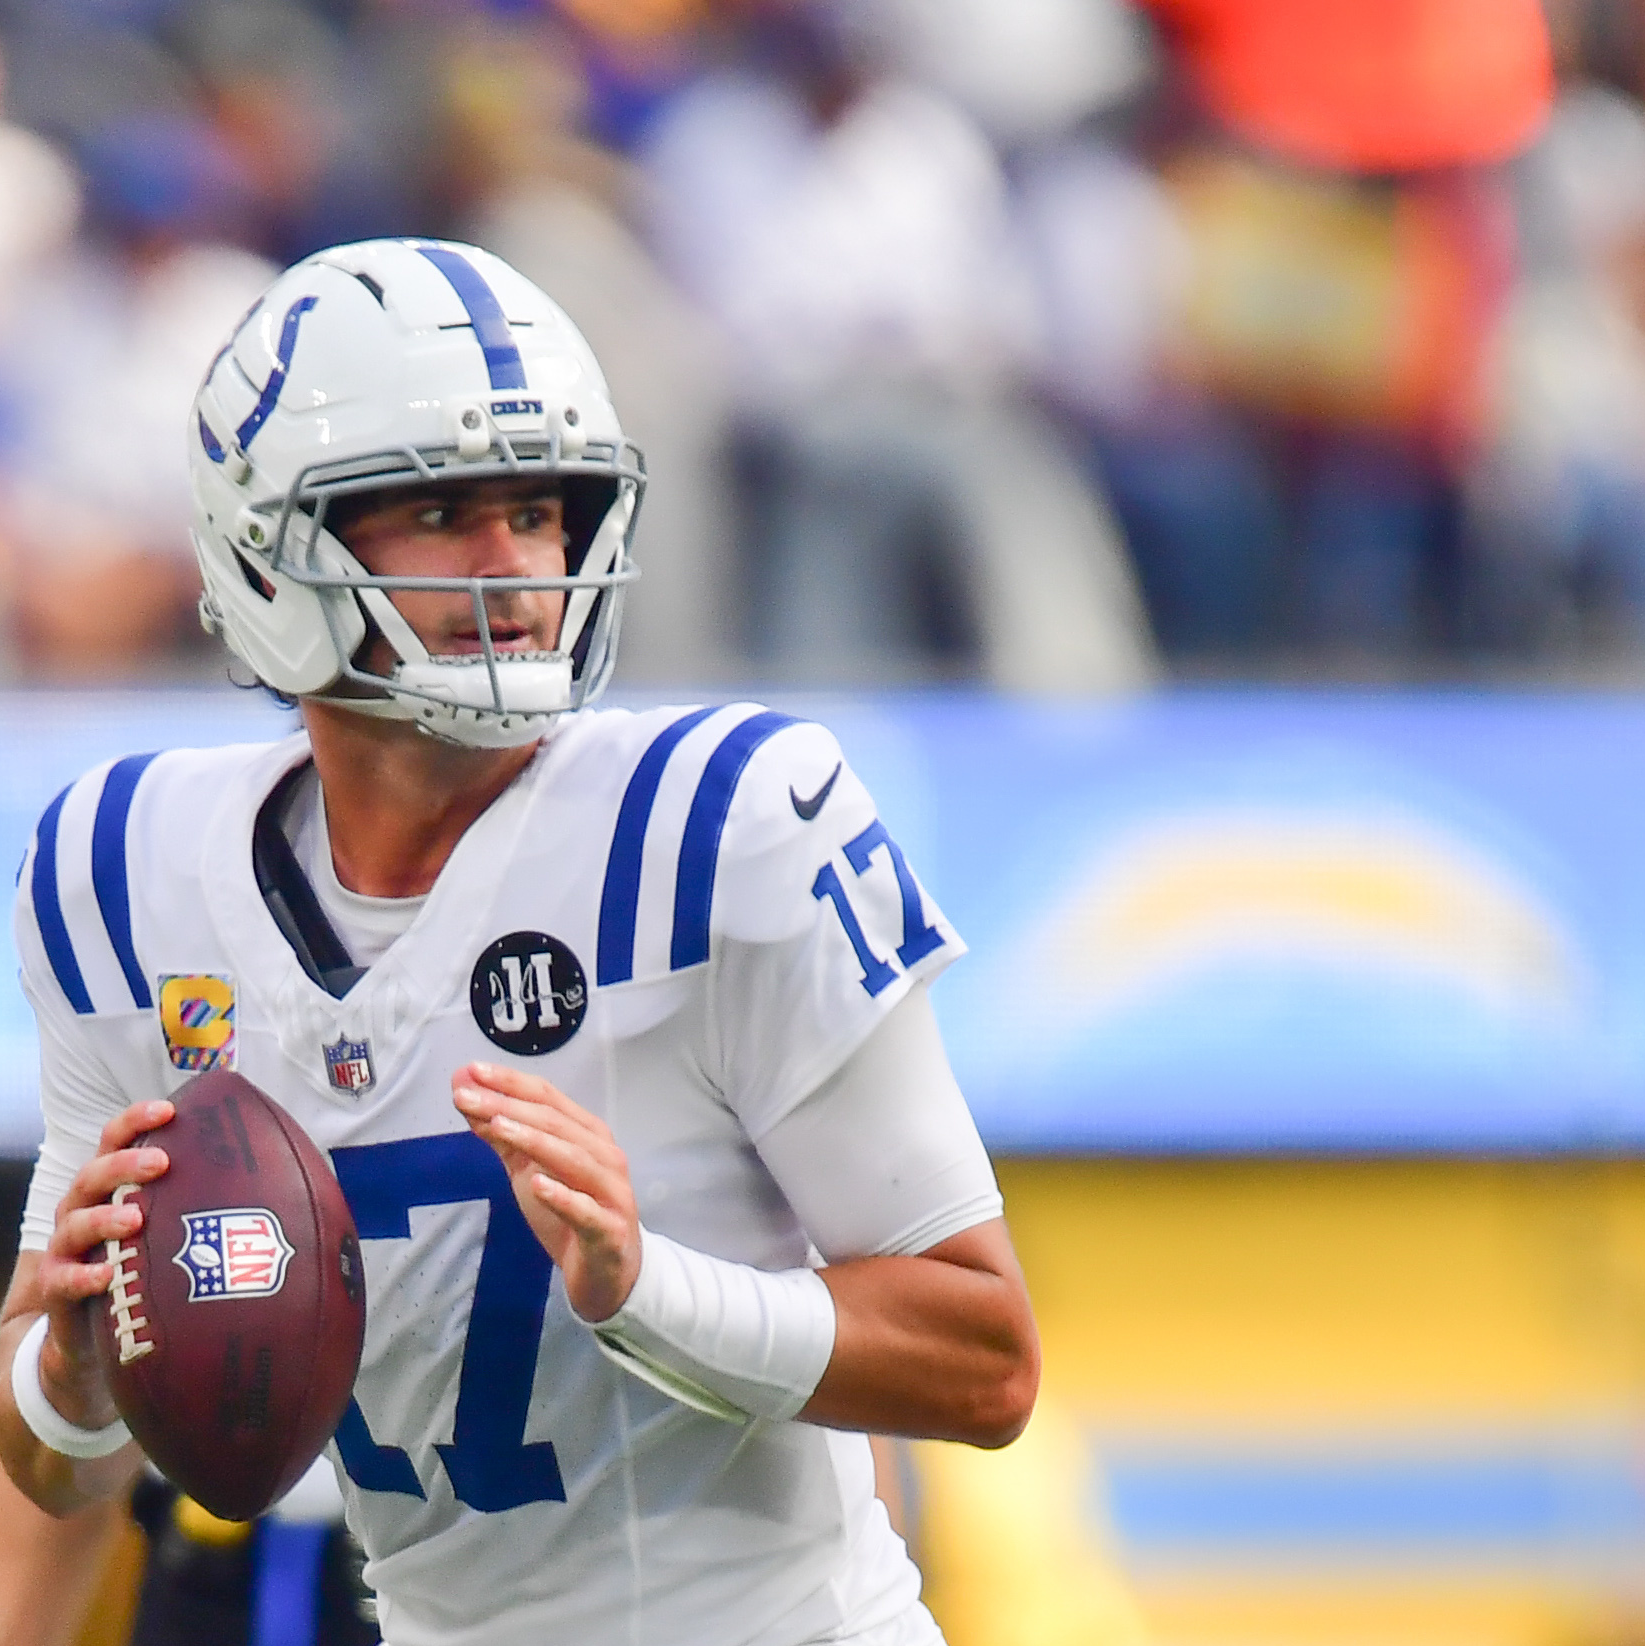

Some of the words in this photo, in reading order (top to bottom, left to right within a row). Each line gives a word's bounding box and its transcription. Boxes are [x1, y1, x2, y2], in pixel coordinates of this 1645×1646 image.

[811, 818, 946, 998] 17
[160, 976, 234, 1048] C
[333, 1061, 369, 1089] NFL
[225, 1218, 278, 1287] NFL
[328, 1130, 567, 1514] 7
